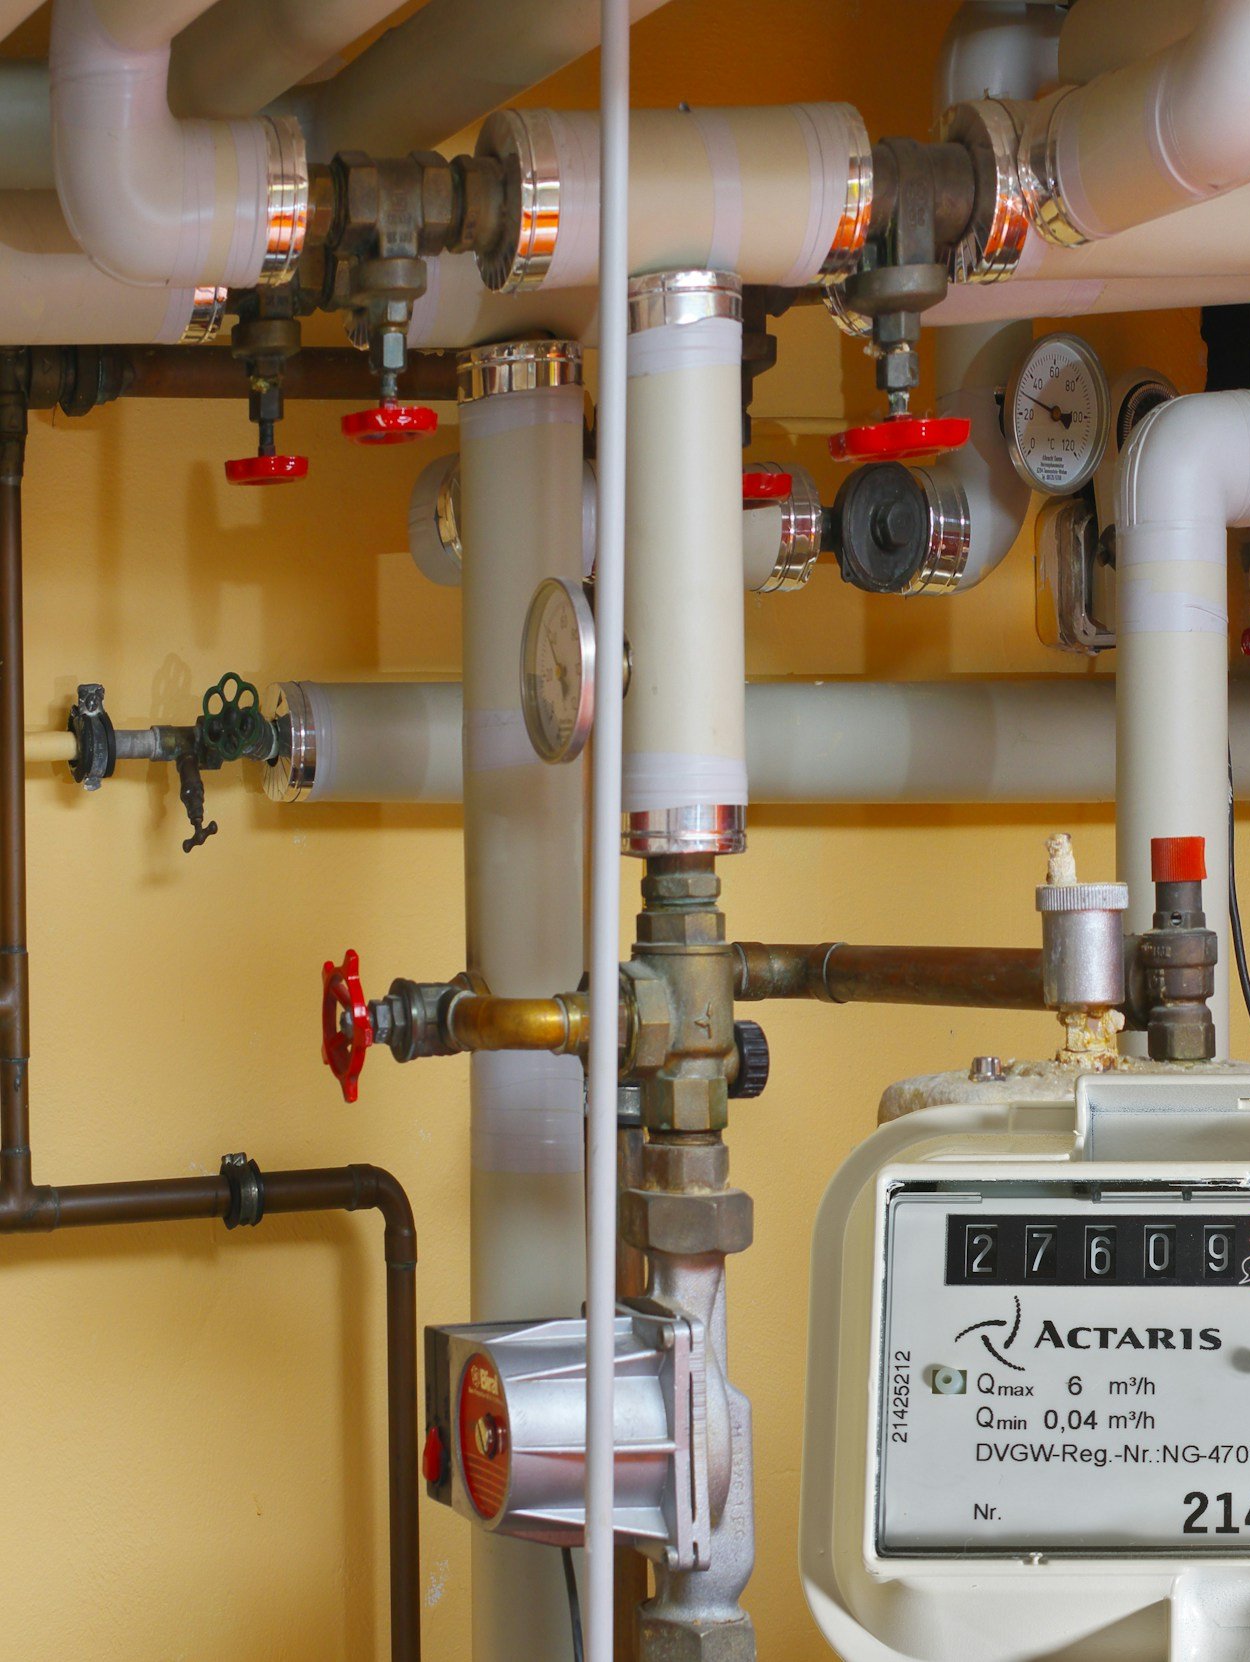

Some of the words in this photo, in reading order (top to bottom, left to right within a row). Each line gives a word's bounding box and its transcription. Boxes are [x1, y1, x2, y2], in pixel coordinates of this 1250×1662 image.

[1050, 366, 1060, 379] 60
[1033, 379, 1043, 390] 40
[1066, 380, 1076, 392] 80
[1024, 408, 1034, 420] 20
[1070, 411, 1083, 423] 00
[1030, 438, 1036, 450] 0
[1062, 439, 1075, 452] 120
[1034, 1320, 1222, 1350] ACTARIS
[977, 1372, 1034, 1397] Qmax
[1067, 1375, 1083, 1396] 6
[1108, 1376, 1155, 1395] m³/h
[891, 1351, 911, 1443] 21425212
[976, 1406, 1027, 1430] Qmin
[1043, 1410, 1098, 1433] 0,04
[1108, 1411, 1155, 1429] m³/h
[973, 1502, 1002, 1521] Nr.
